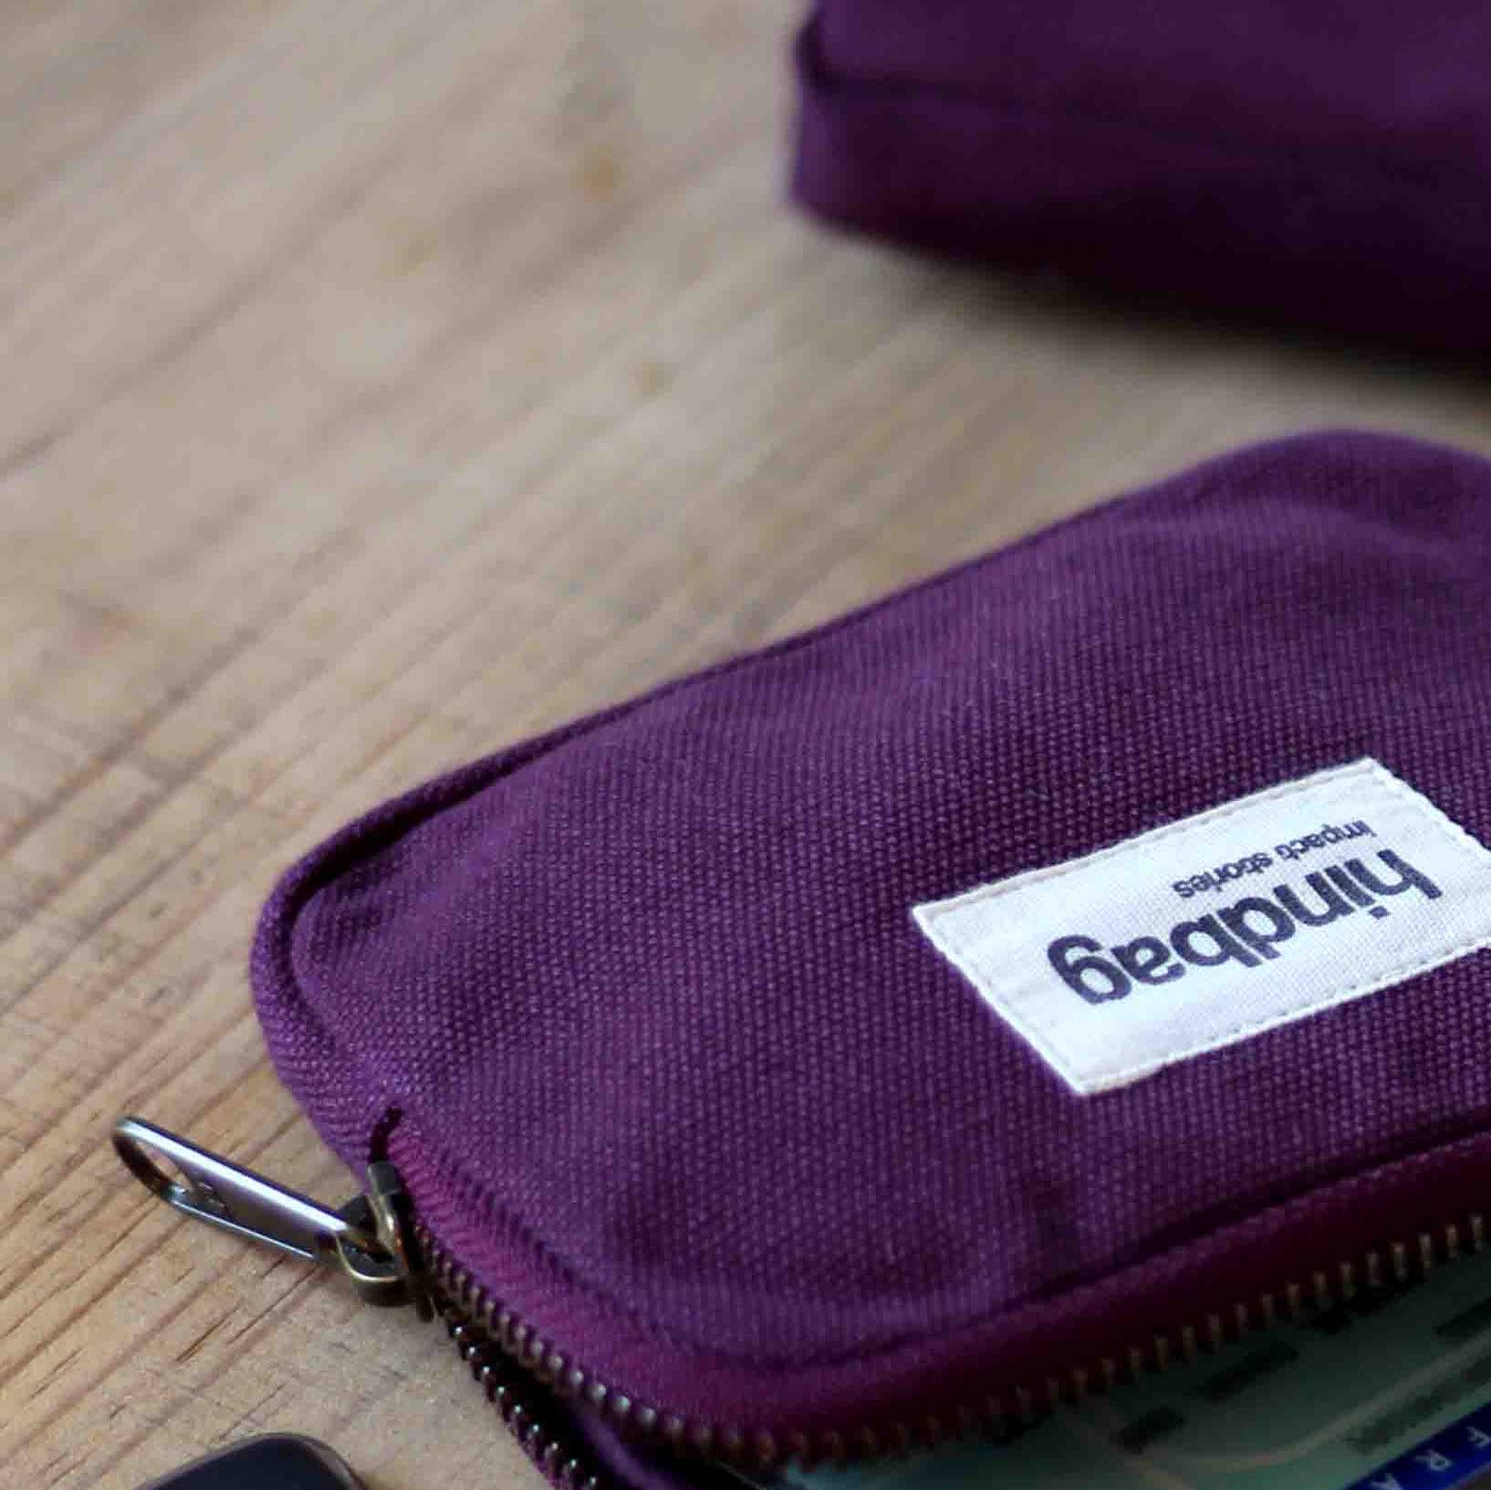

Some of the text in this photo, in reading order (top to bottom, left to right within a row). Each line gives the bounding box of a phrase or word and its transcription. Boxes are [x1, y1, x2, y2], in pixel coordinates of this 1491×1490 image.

[1172, 820, 1376, 900] impact stories
[1047, 849, 1443, 1005] hindbag
